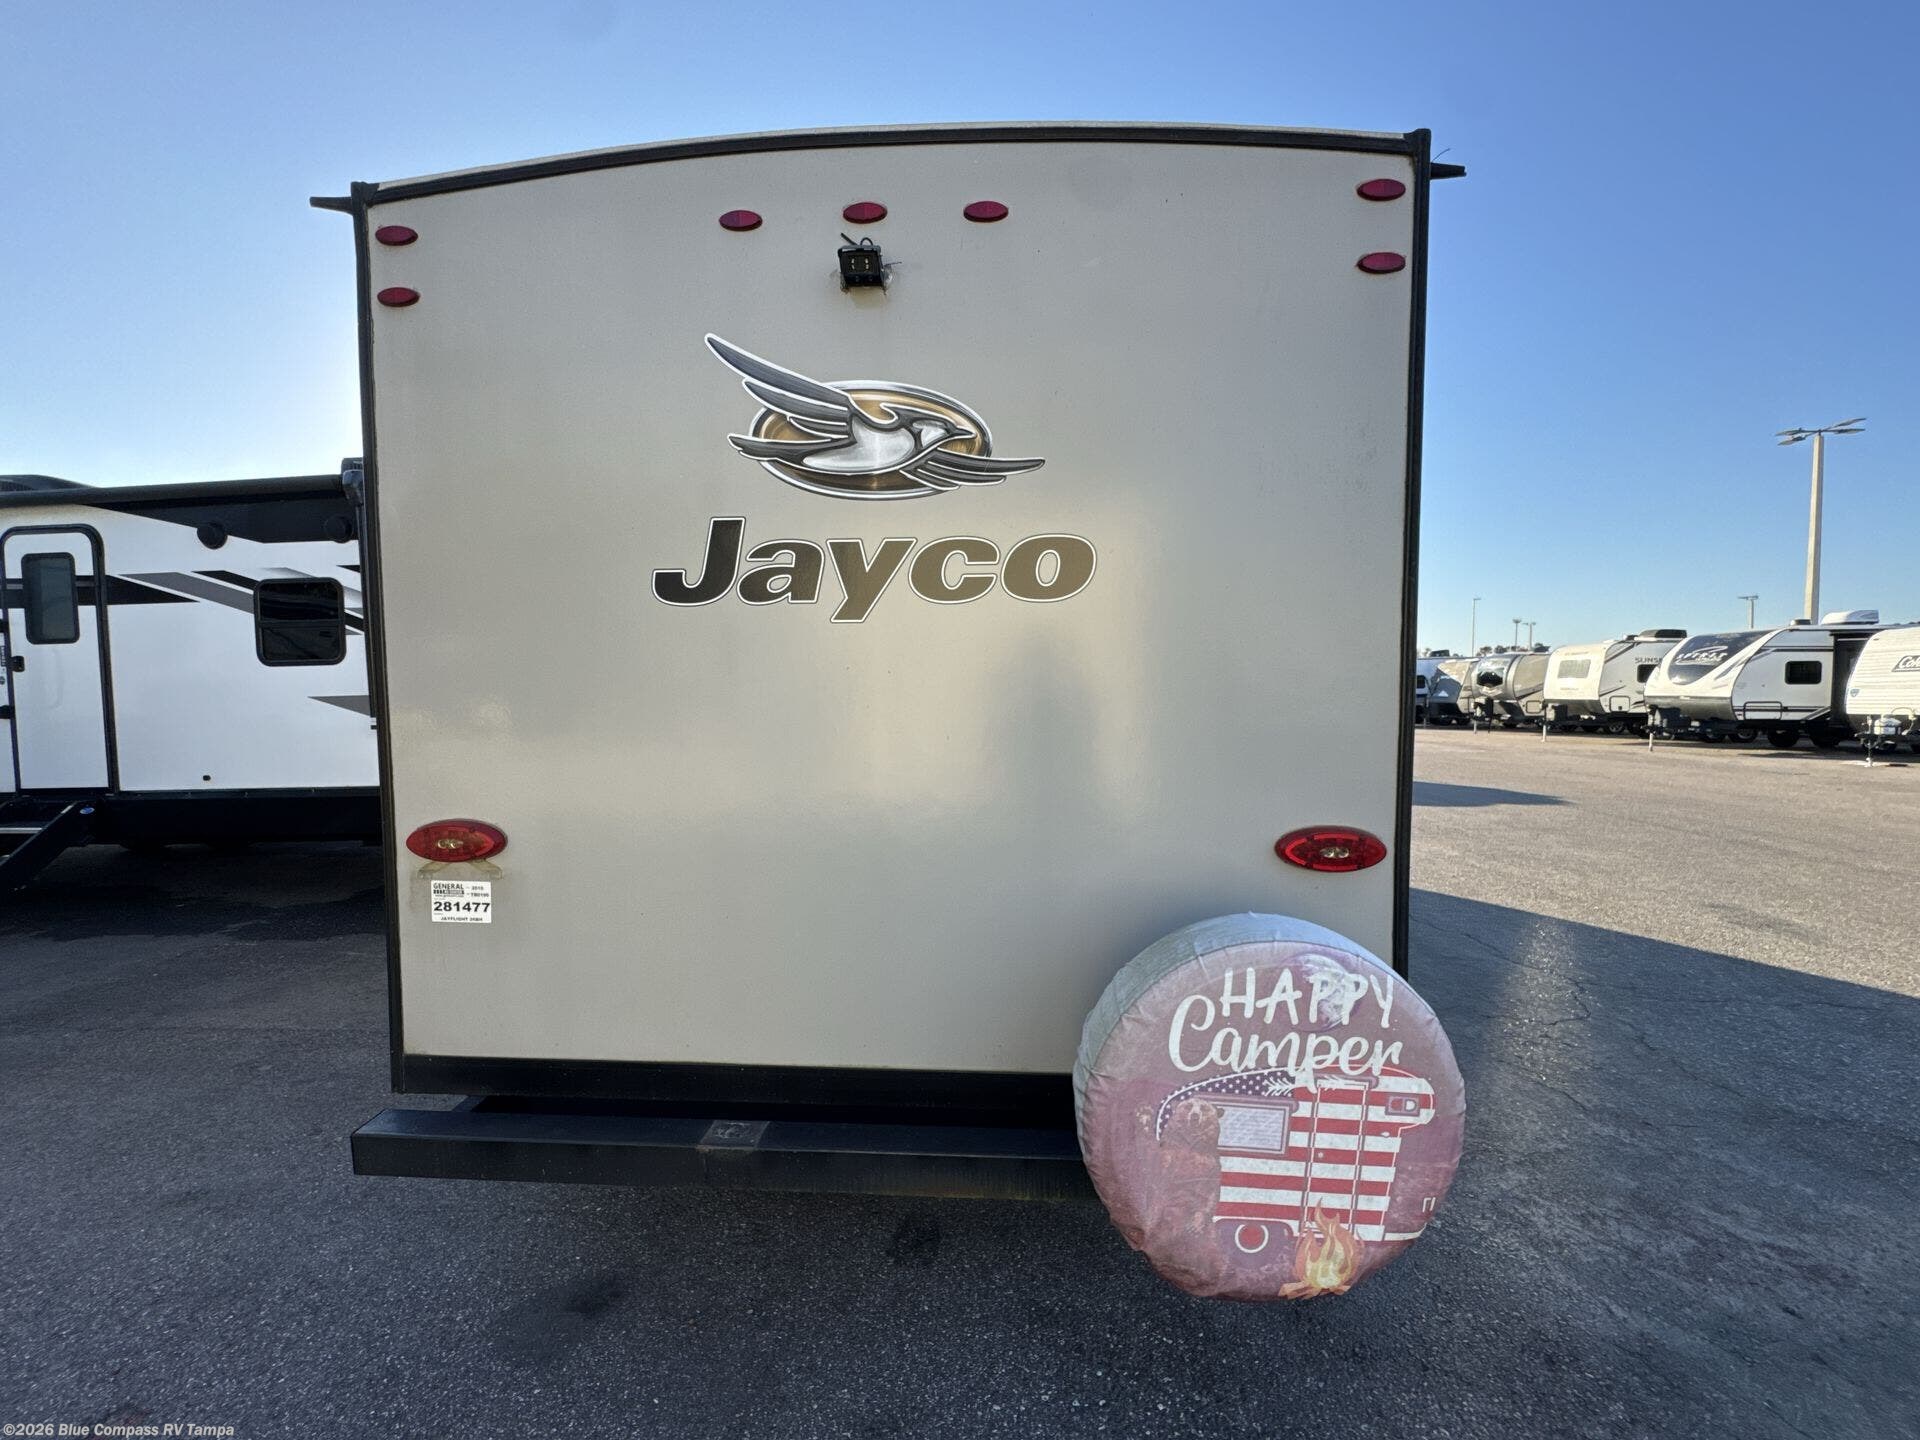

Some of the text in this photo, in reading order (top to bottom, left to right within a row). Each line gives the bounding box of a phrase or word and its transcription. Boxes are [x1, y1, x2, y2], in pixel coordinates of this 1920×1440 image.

[651, 516, 1097, 623] Jayco
[434, 901, 490, 912] 281477
[1221, 966, 1395, 1028] HAPPY
[1168, 994, 1403, 1093] Camper
